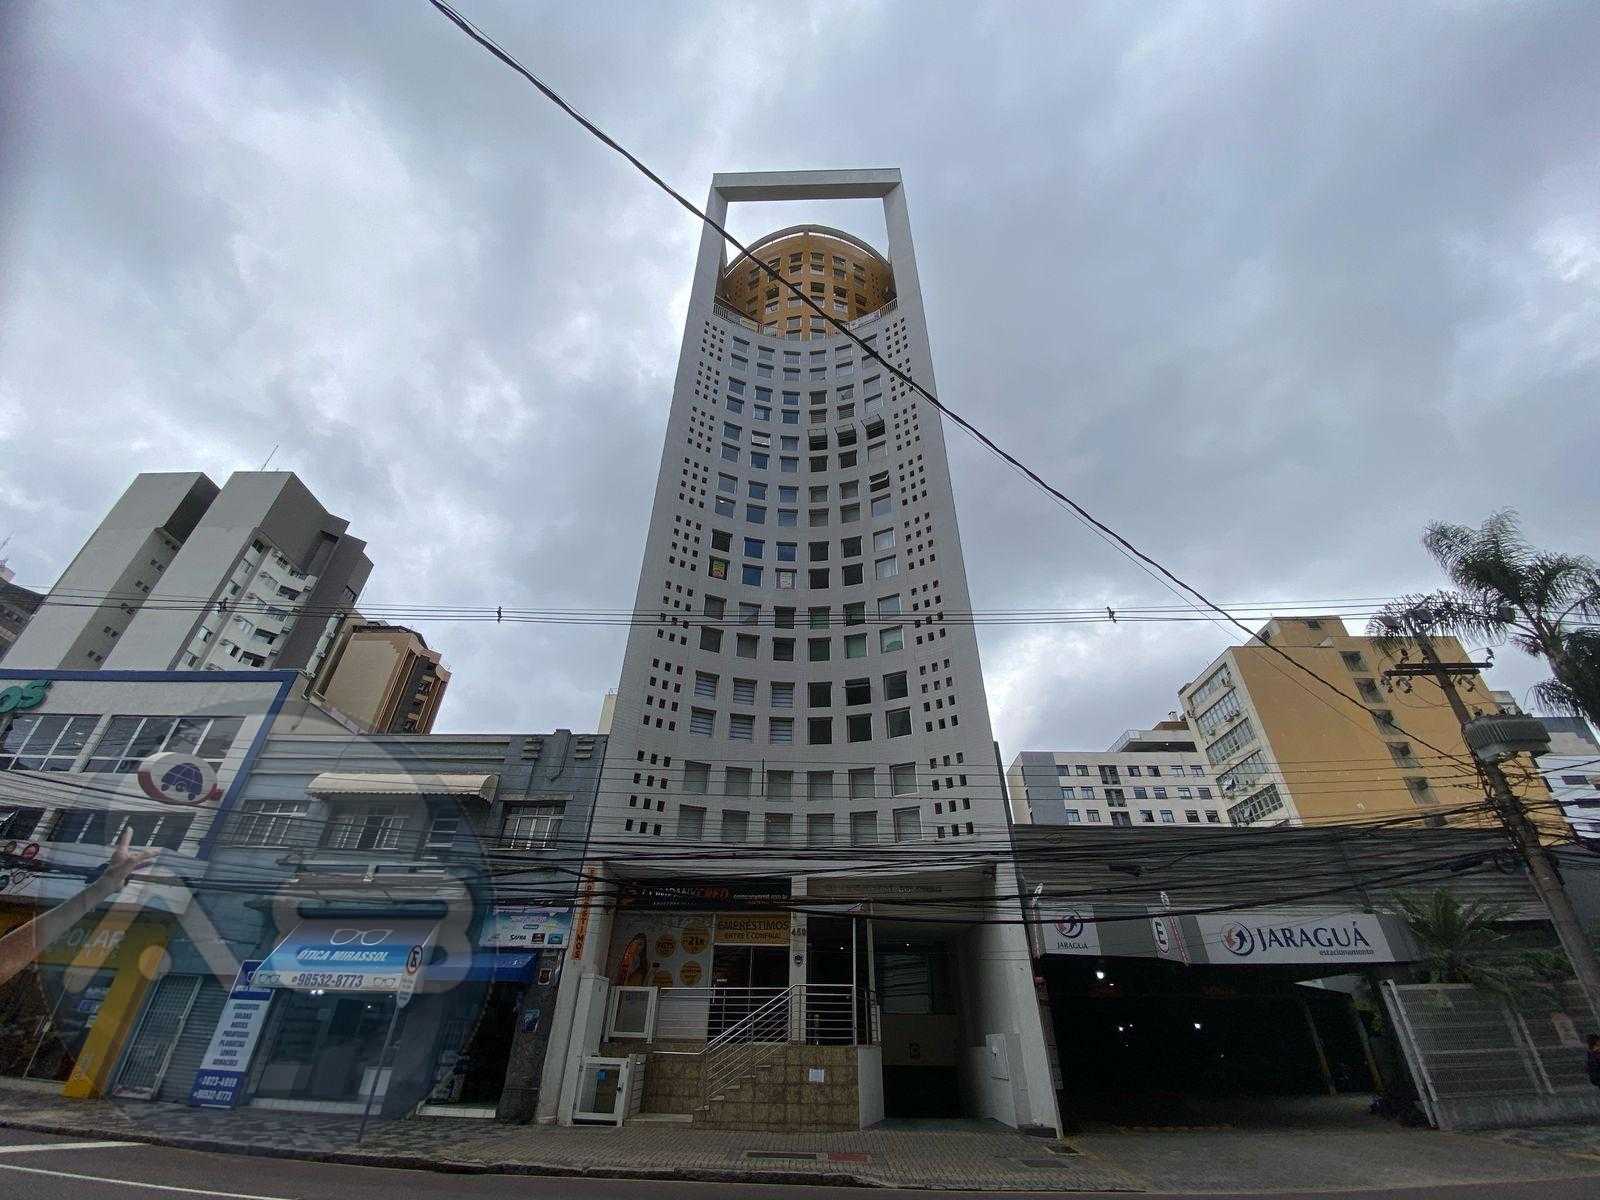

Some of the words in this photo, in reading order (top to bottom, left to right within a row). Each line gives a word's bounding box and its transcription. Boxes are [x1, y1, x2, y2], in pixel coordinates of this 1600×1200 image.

[1256, 921, 1372, 951] JARAGUÁ
[296, 948, 330, 961] ÓTICA
[330, 950, 389, 962] MIRASSOL
[297, 973, 364, 988] 98532-8773
